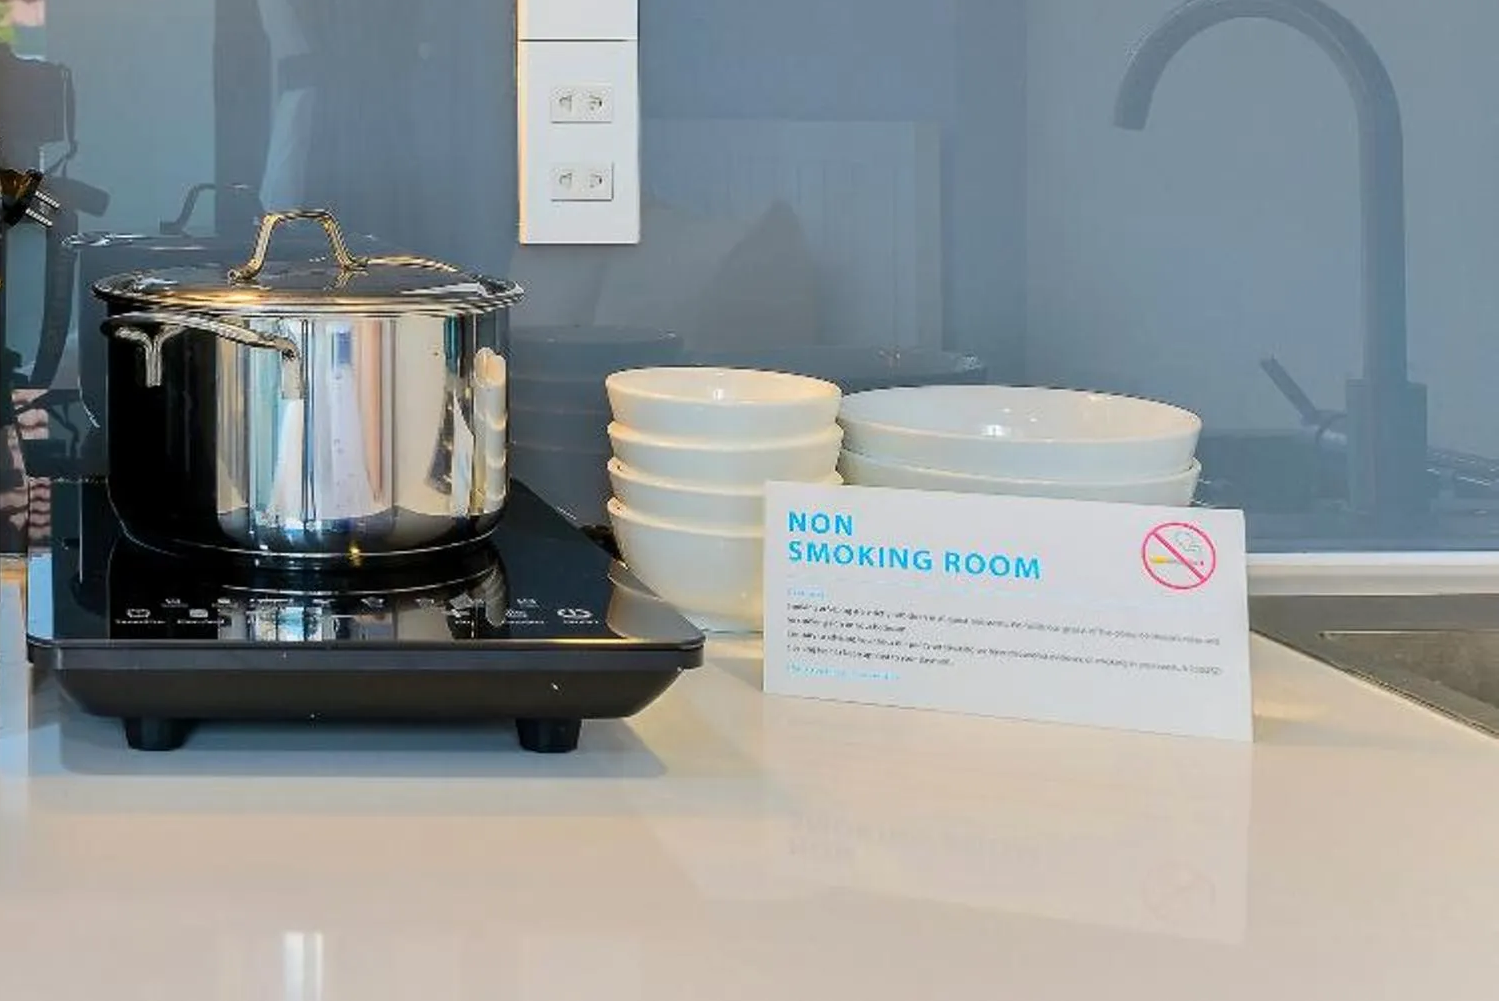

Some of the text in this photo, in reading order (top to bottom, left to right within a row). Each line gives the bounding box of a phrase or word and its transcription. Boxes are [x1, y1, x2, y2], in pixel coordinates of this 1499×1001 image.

[787, 510, 853, 537] NON
[788, 540, 1041, 580] SMOKING ROOM
